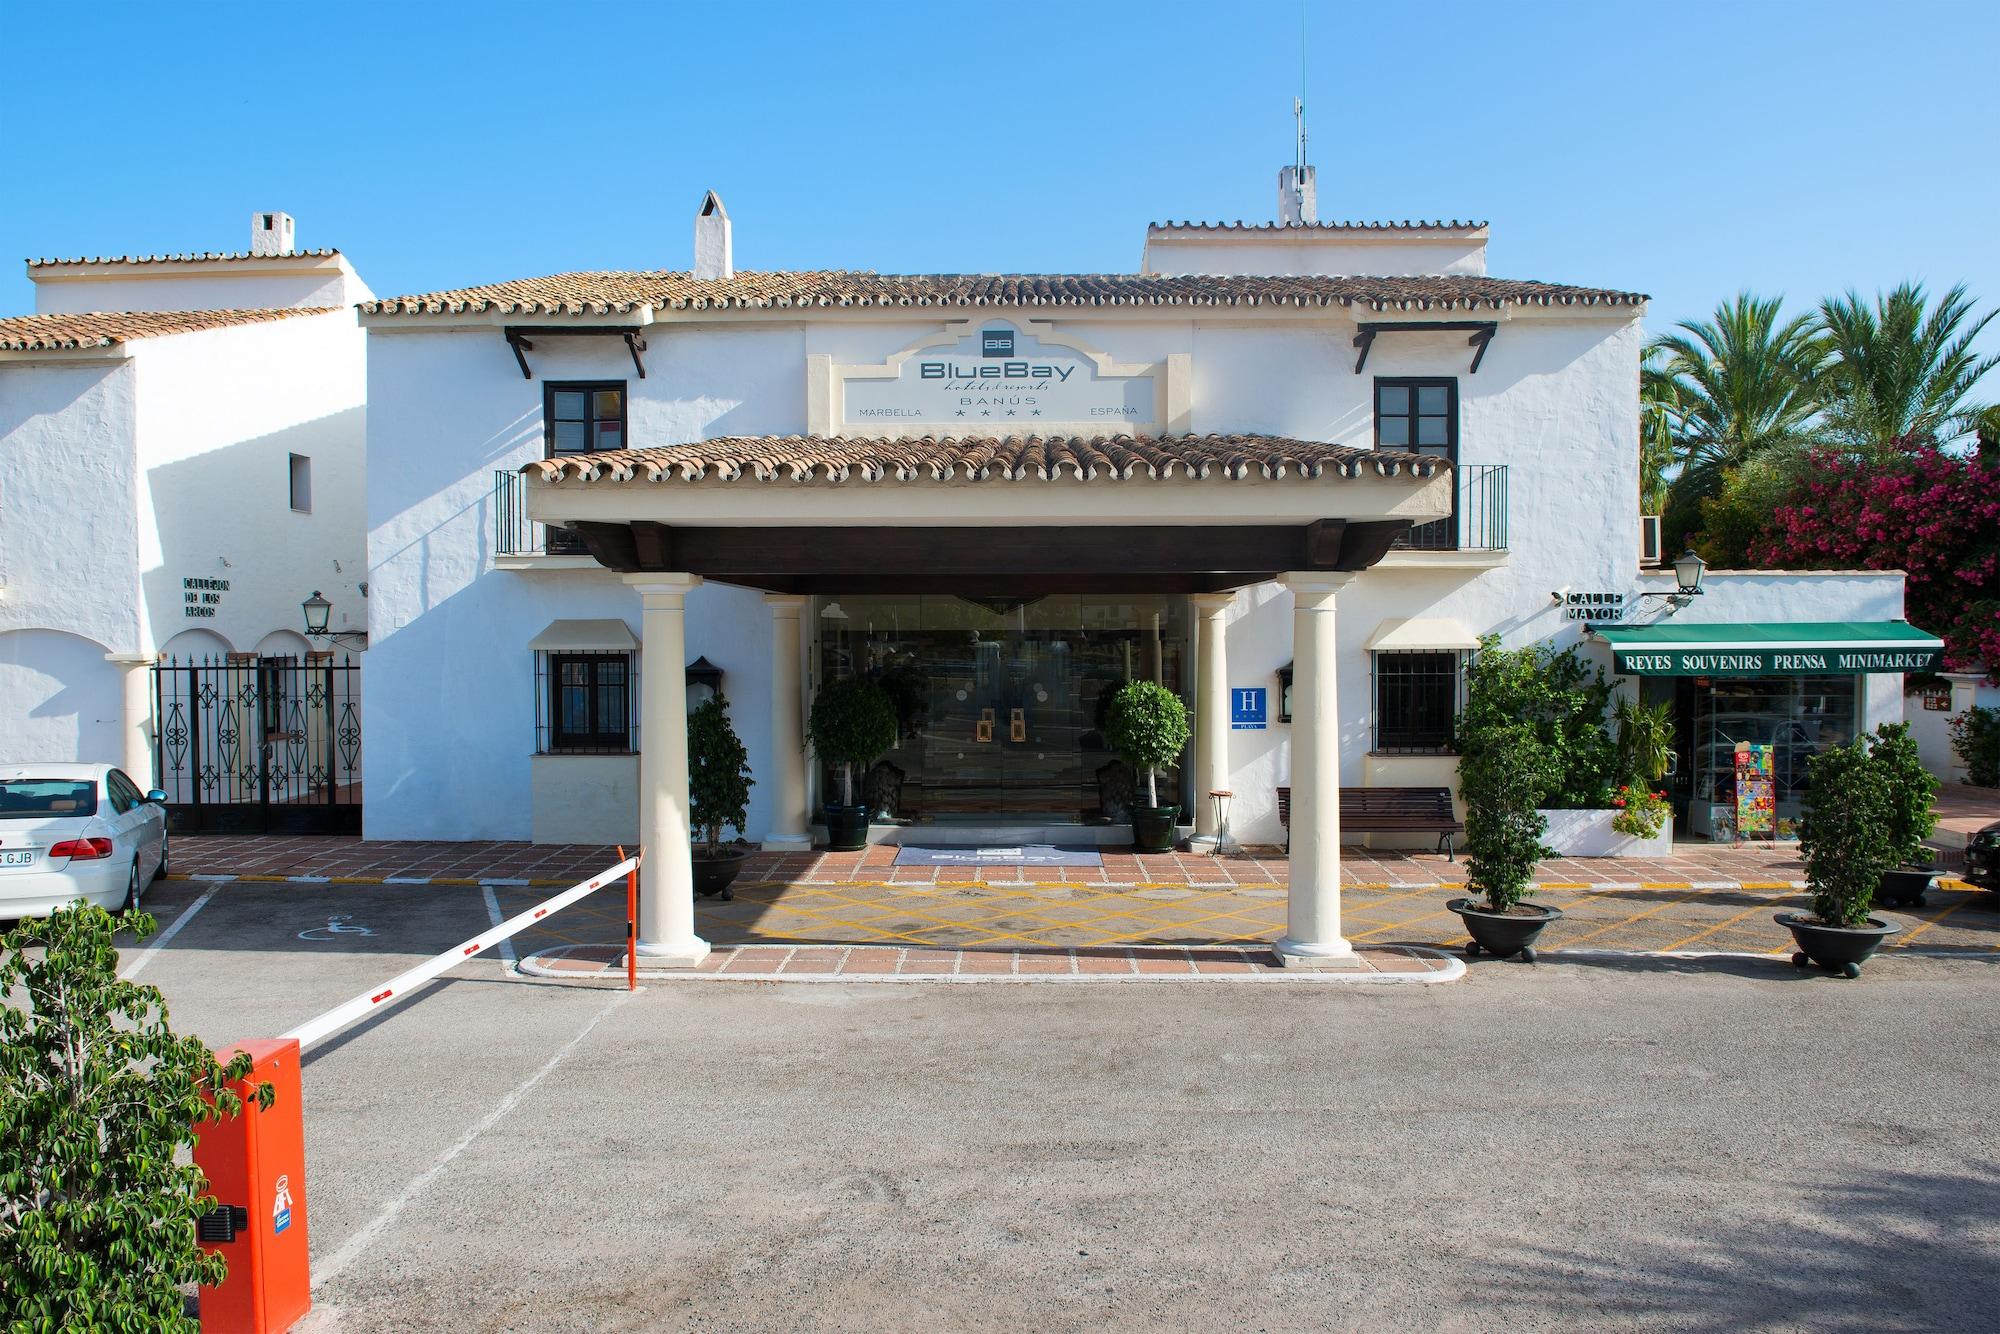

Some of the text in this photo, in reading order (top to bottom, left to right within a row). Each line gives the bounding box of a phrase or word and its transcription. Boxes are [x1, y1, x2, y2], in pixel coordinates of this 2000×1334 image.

[984, 339, 1012, 349] BB
[920, 362, 1075, 382] BlueBay
[944, 380, 989, 391] hotels
[1004, 380, 1049, 391] resorts
[960, 395, 1037, 406] BANÚS
[859, 408, 922, 417] MARBELLA
[1090, 404, 1138, 416] ESPAÑA
[185, 592, 220, 604] DE LOS
[1566, 593, 1623, 605] CALLE
[185, 606, 215, 617] ARCOS
[1566, 608, 1623, 620] MAYOR
[1625, 653, 1933, 670] REYES SOUVENIRS PRENSA MINIMARKET
[1240, 691, 1257, 711] H
[6, 853, 32, 864] GJB
